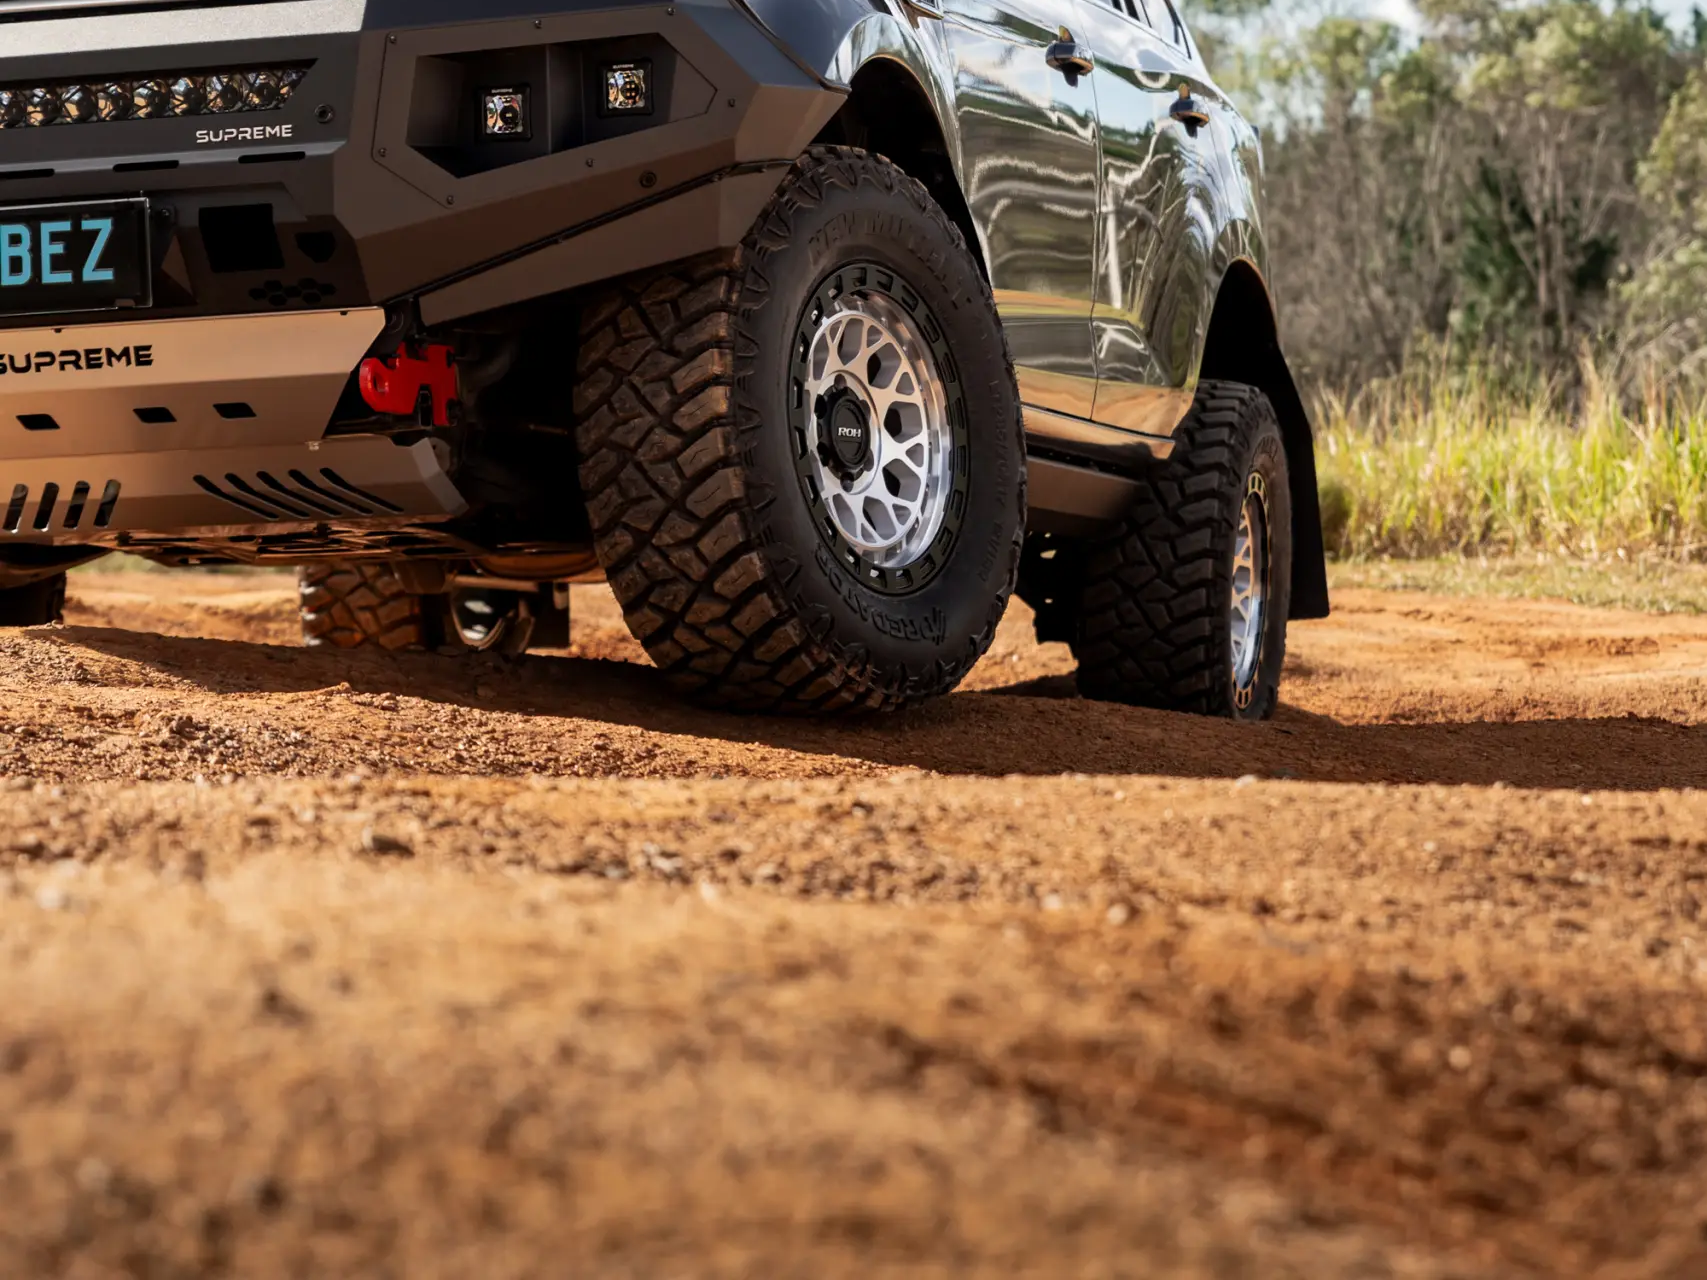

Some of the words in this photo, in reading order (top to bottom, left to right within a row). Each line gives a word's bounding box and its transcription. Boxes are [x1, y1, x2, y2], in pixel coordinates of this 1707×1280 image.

[195, 124, 293, 144] SUPREME
[0, 217, 115, 286] BEZ
[837, 426, 862, 438] ROH
